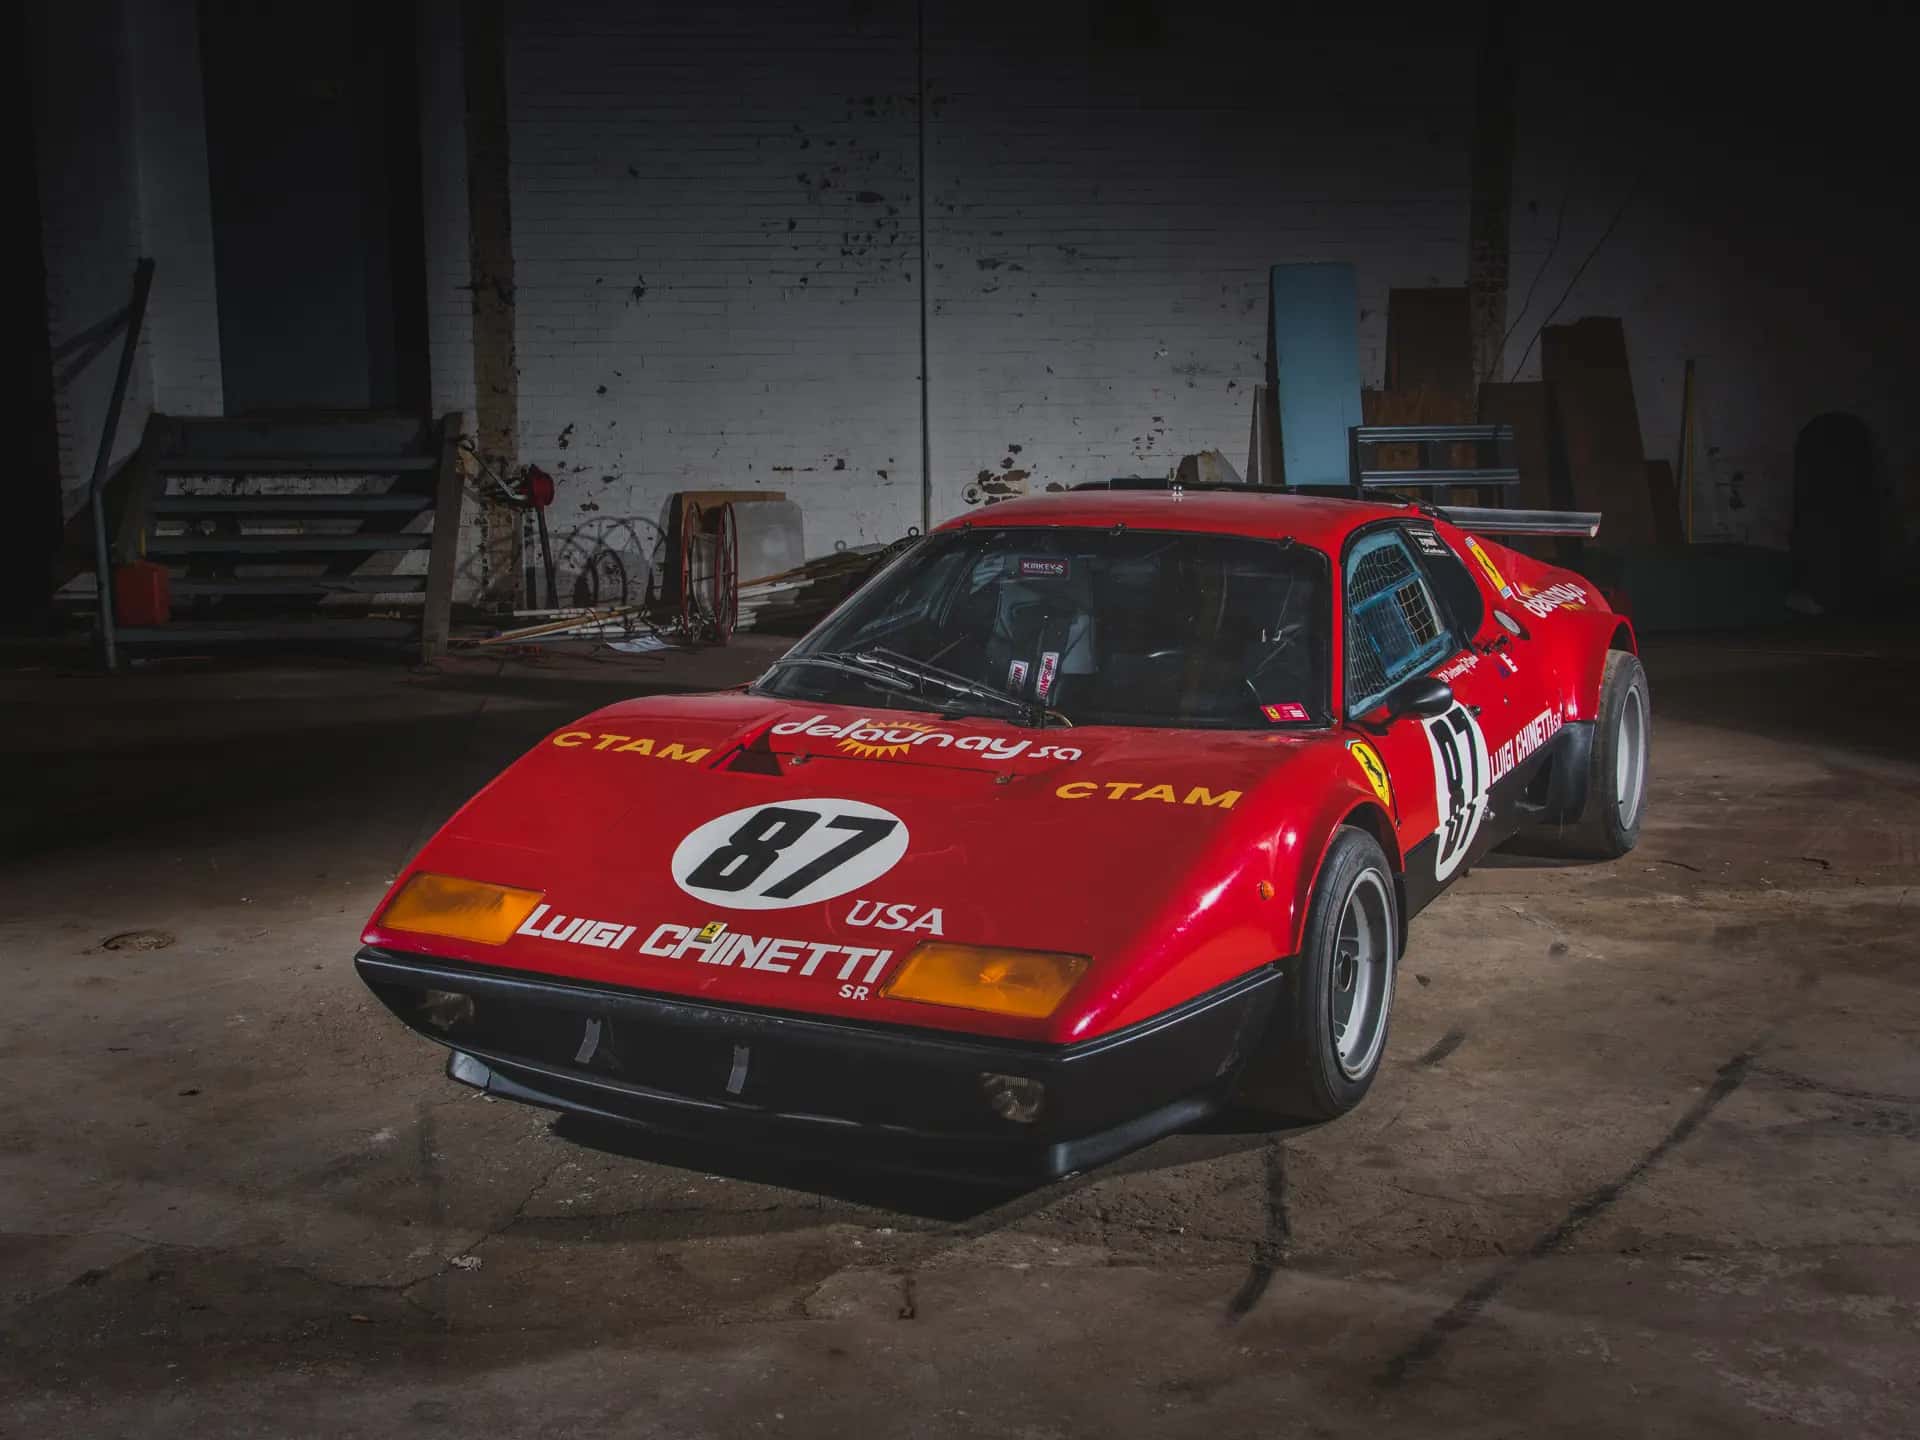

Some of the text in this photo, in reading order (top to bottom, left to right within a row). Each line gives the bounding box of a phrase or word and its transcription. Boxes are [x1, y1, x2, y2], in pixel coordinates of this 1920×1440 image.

[552, 731, 712, 763] CTAM
[770, 714, 1033, 759] delaunay
[1489, 738, 1516, 786] LUIGI
[1515, 706, 1555, 764] CHINETTI
[1055, 781, 1243, 809] CTAM
[684, 806, 901, 900] 87
[845, 899, 945, 936] USA
[515, 903, 893, 984] LUIGI CHINETTI
